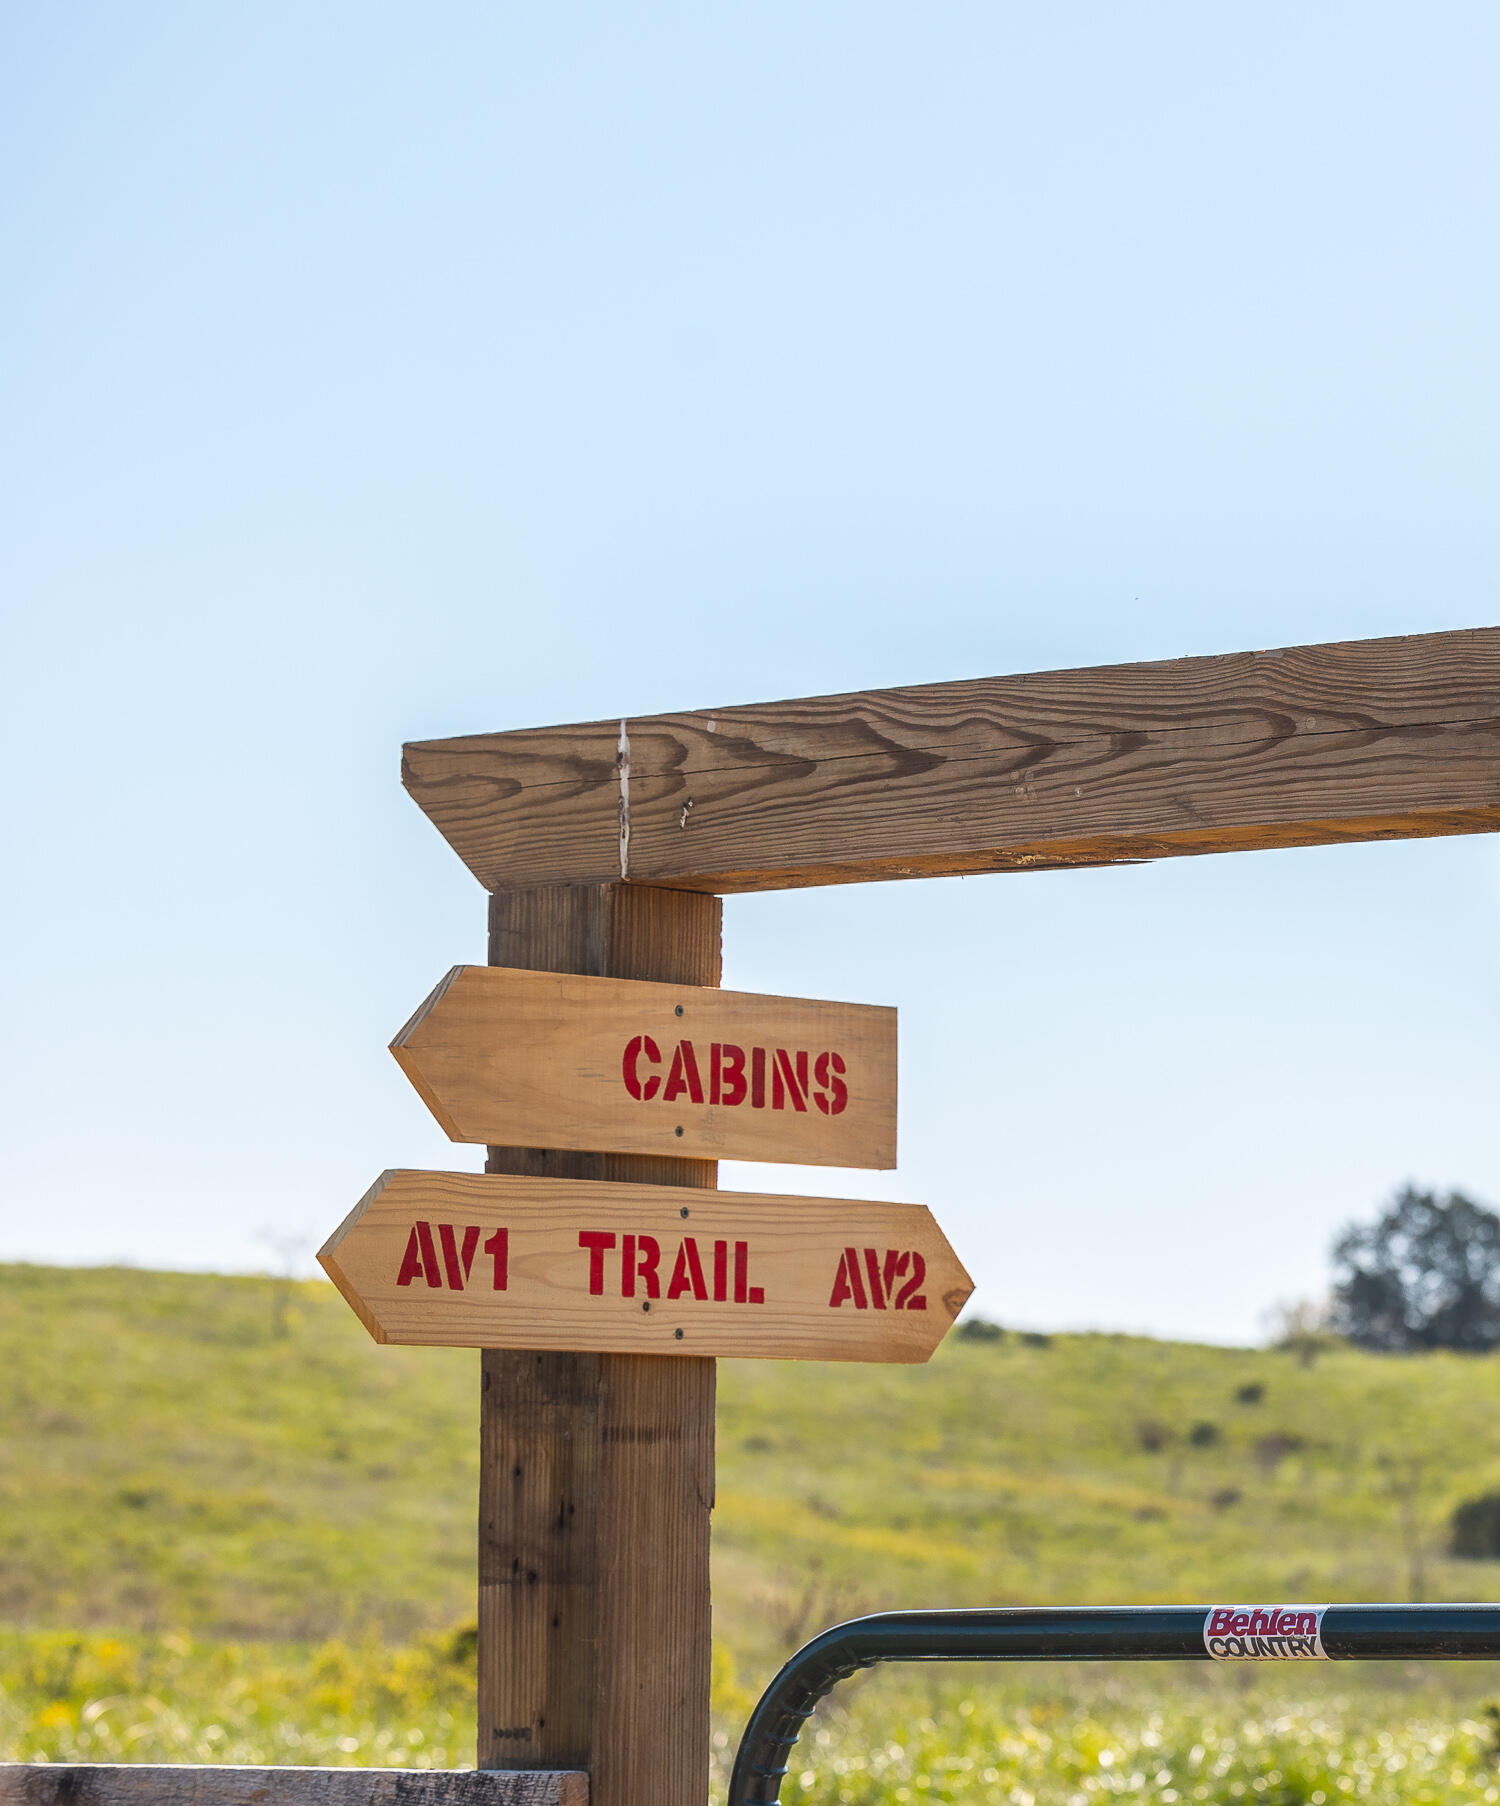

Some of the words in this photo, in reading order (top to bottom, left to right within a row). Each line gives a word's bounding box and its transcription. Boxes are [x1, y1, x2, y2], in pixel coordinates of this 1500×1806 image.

[622, 1035, 849, 1116] CABINS
[396, 1221, 509, 1291] AV1
[578, 1230, 765, 1305] TRAIL
[828, 1247, 928, 1311] AV2
[1207, 1608, 1317, 1636] Behlen
[1209, 1636, 1317, 1657] COUNTRY
